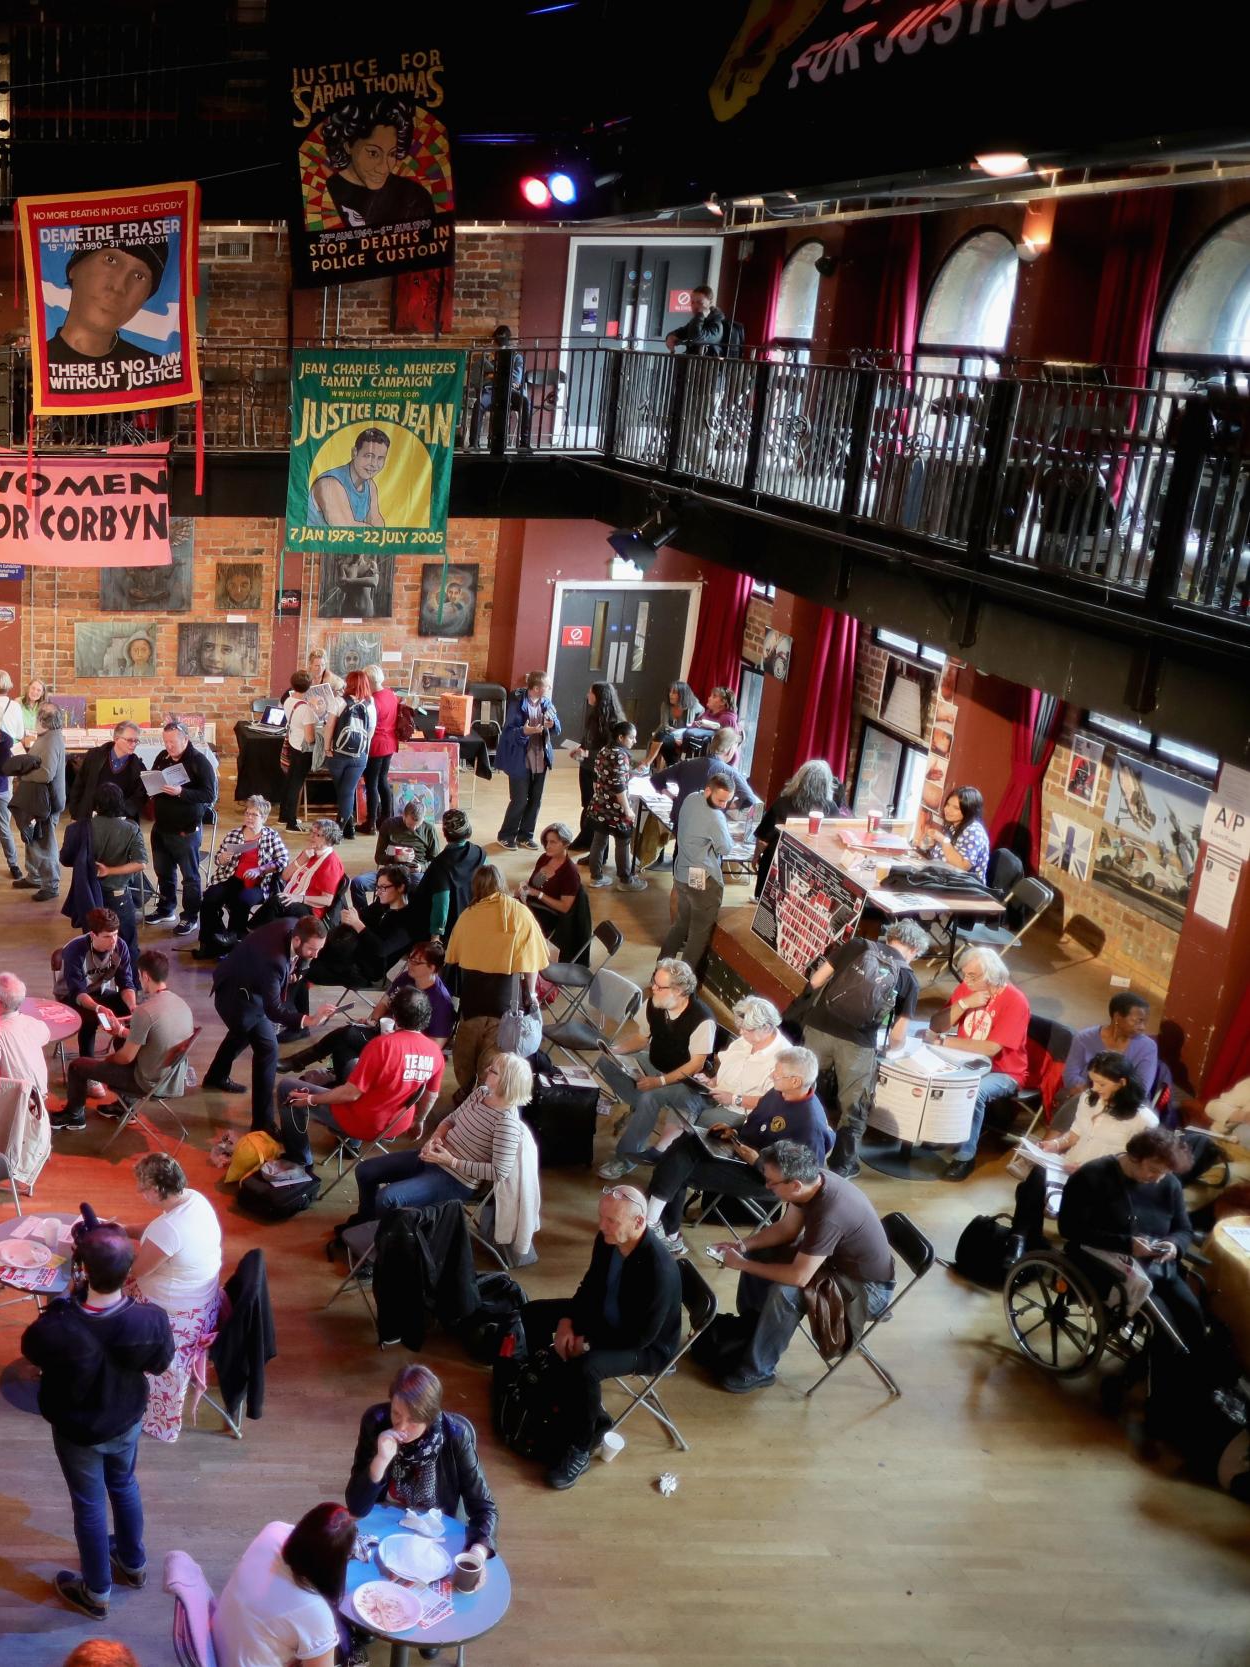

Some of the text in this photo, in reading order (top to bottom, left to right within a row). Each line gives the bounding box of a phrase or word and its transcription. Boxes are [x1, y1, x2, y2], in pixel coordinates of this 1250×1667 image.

[293, 49, 442, 86] JUSTICE FOR
[788, 21, 878, 89] FOR
[292, 65, 445, 128] SARAH THOMAS
[33, 200, 184, 220] NO MORE DEATHS IN POLICE CUSTODY
[40, 218, 181, 244] DEMETRE FRASER
[125, 237, 147, 248] MAY
[148, 234, 169, 245] 2011
[309, 225, 450, 256] STOP DEATHS IN
[311, 240, 449, 272] POLICE CUSTODY
[49, 353, 182, 377] THERE IS NO LAW
[50, 364, 182, 391] WITHOUT JUSTICE
[299, 362, 456, 380] JEAN CHARLES de MENEZES
[321, 375, 433, 388] FAMILY CAMPAIGN
[294, 398, 454, 448] JUSTICE FOR JEAN
[40, 503, 168, 542] CORBYN
[290, 527, 299, 539] 7
[299, 526, 325, 542] JAN
[380, 529, 409, 547] JULY
[411, 531, 444, 544] 2005
[405, 1054, 434, 1072] TEAM
